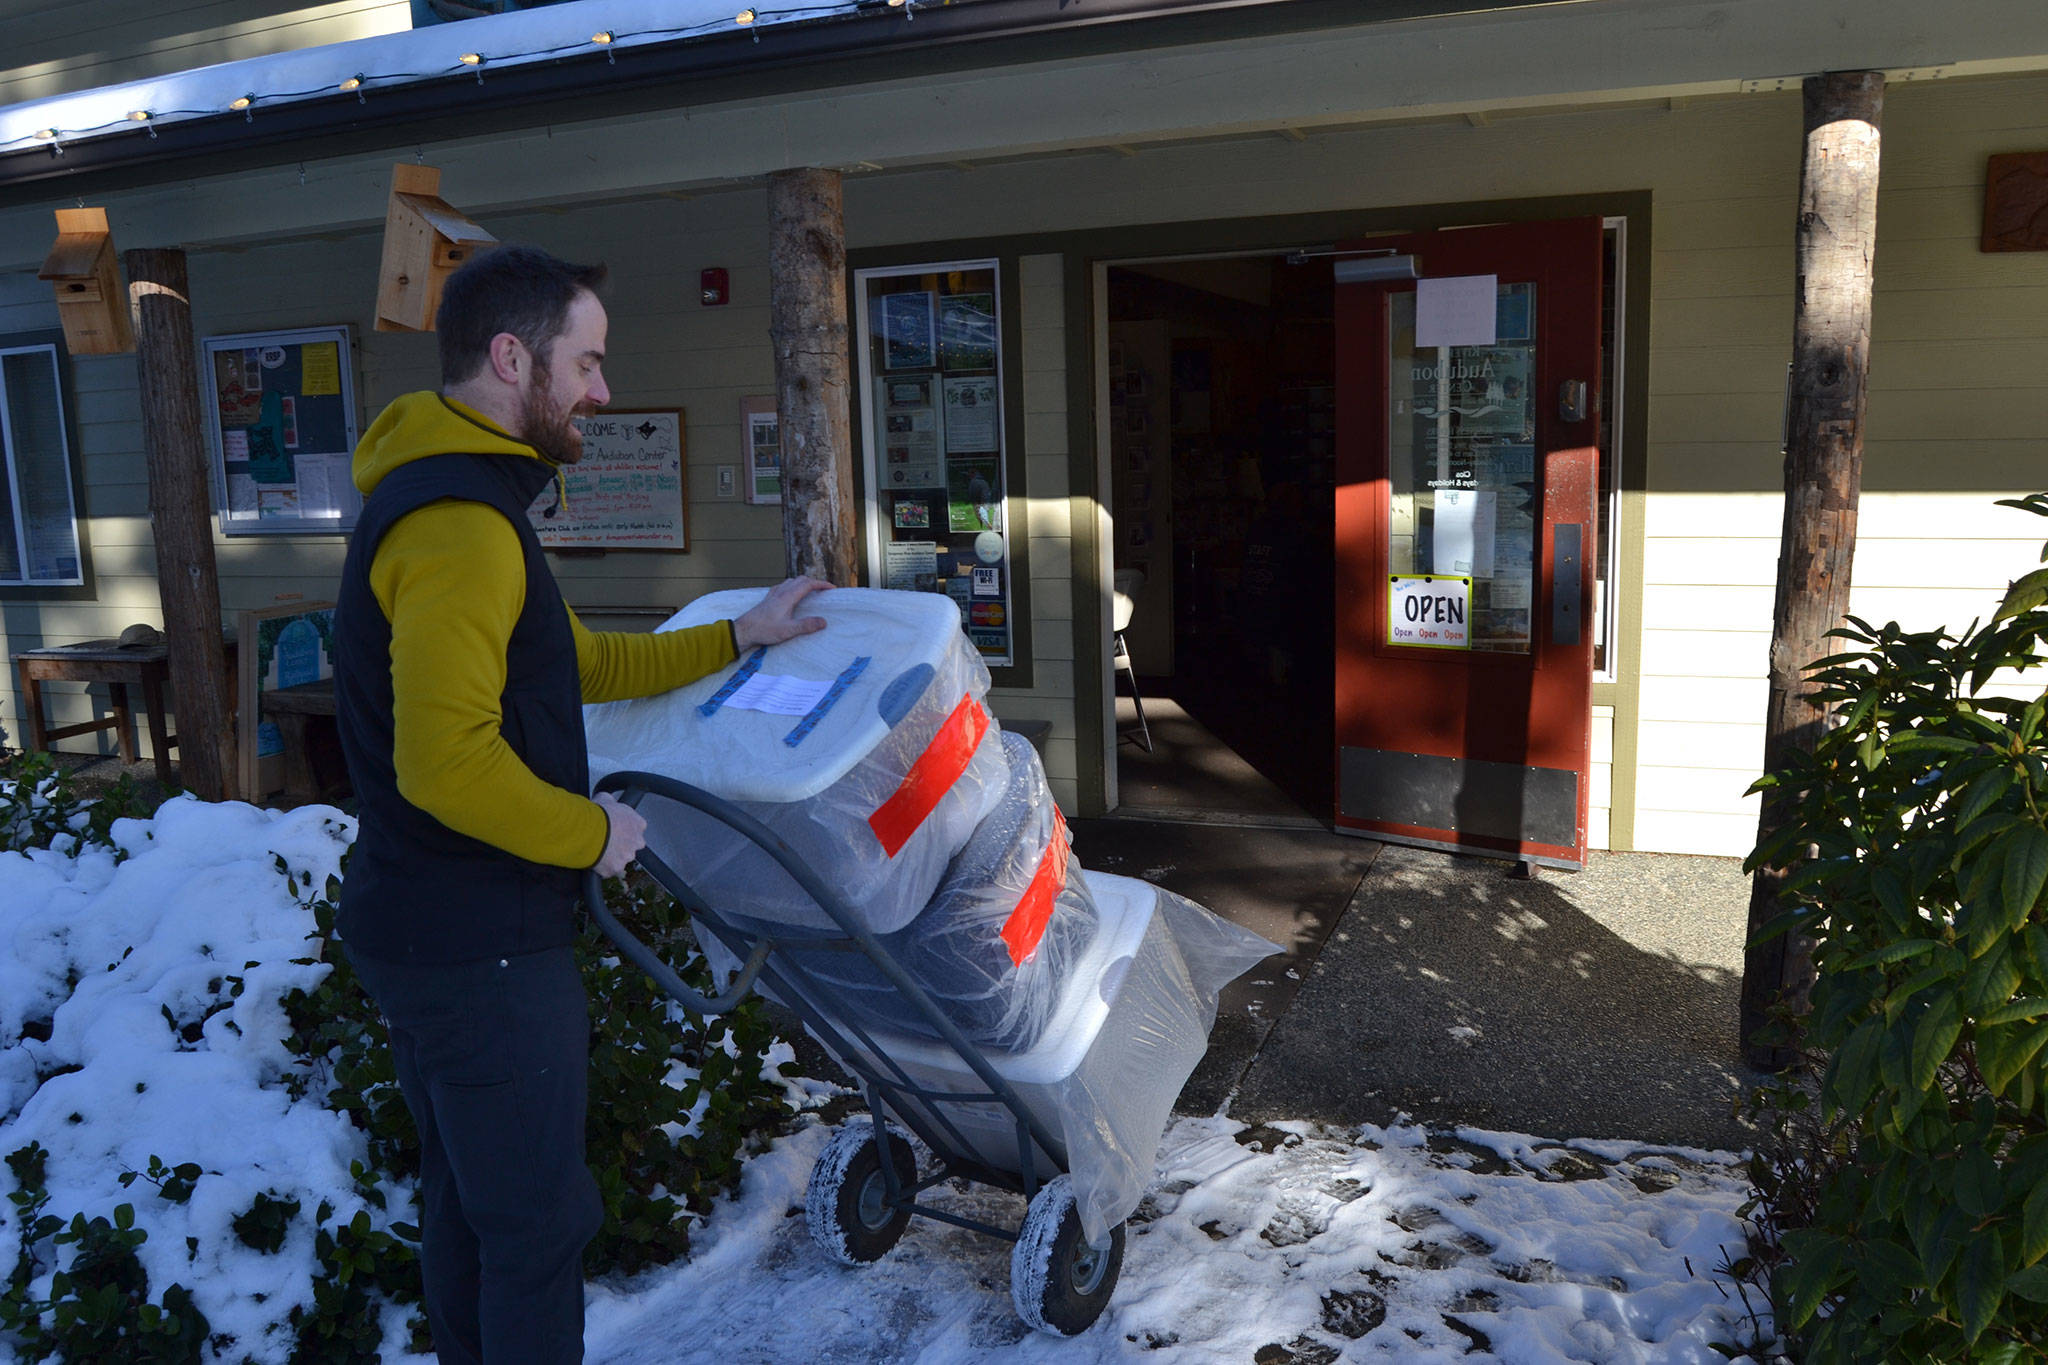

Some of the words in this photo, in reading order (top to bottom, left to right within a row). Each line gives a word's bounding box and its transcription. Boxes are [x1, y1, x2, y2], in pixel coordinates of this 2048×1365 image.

[596, 447, 635, 461] Audubon
[638, 447, 667, 461] Center
[975, 569, 993, 578] FREE
[1405, 595, 1464, 624] OPEN
[1394, 627, 1413, 638] Open
[1419, 628, 1438, 639] Open
[1444, 629, 1464, 640] Open
[977, 636, 1001, 646] VISA
